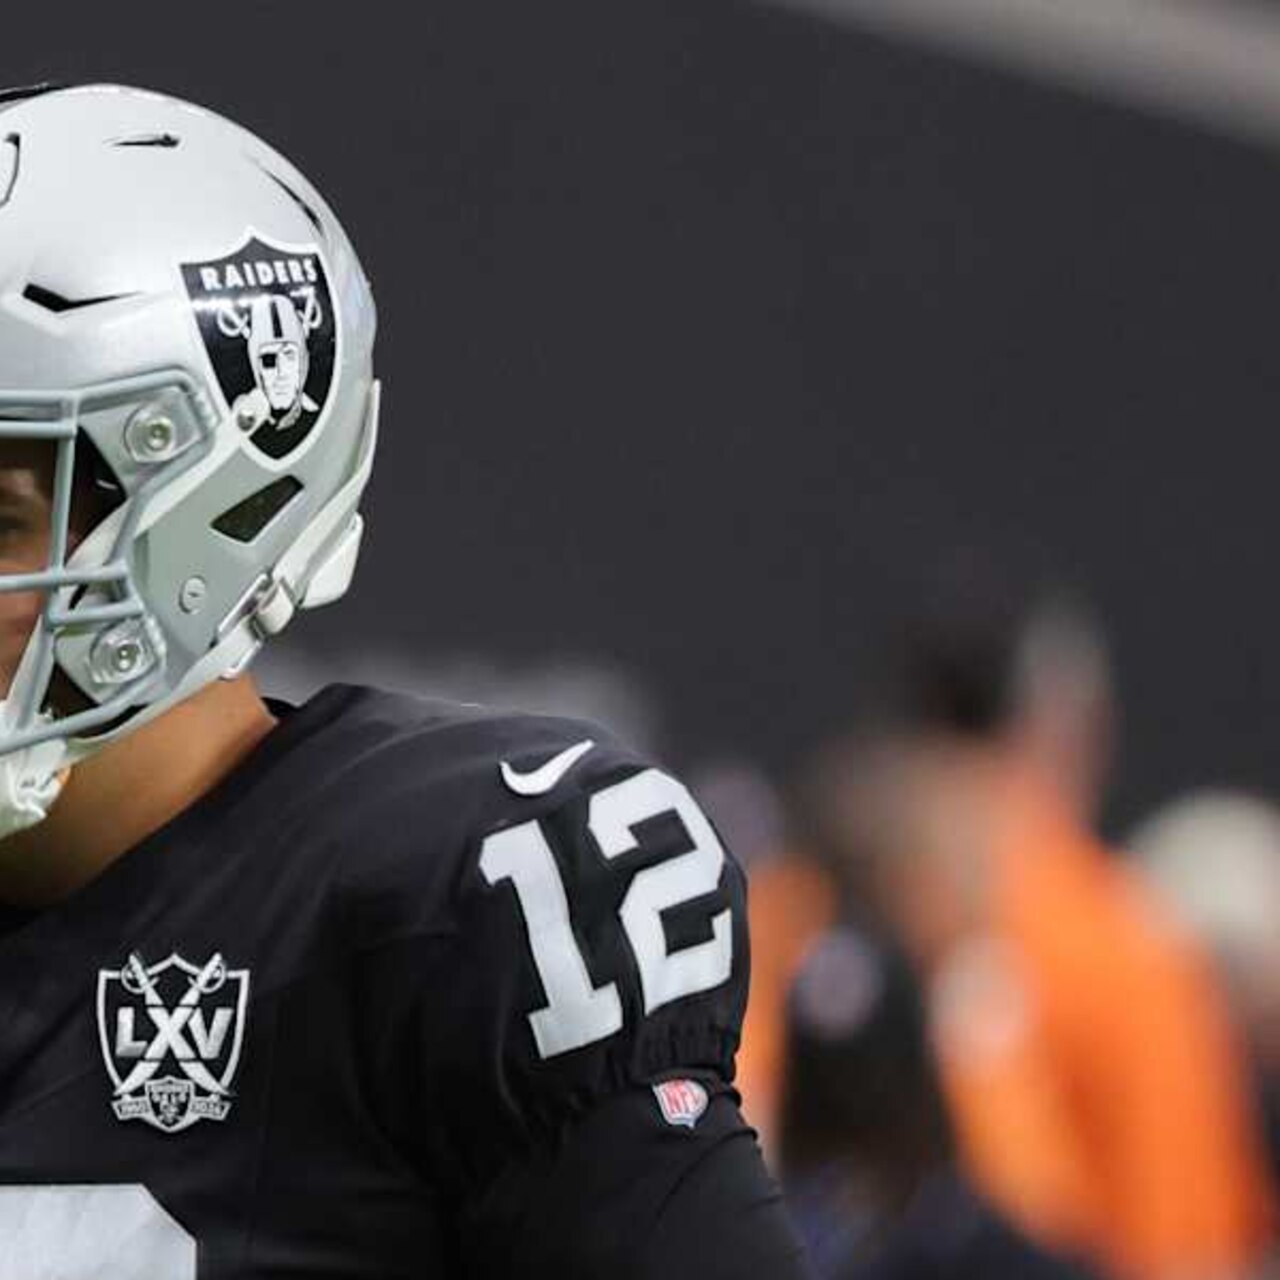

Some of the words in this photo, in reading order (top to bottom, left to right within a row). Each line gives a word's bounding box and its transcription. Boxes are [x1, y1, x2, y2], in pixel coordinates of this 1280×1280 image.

[199, 258, 318, 291] RAIDERS
[478, 767, 733, 1059] 12
[114, 1006, 234, 1061] LXV
